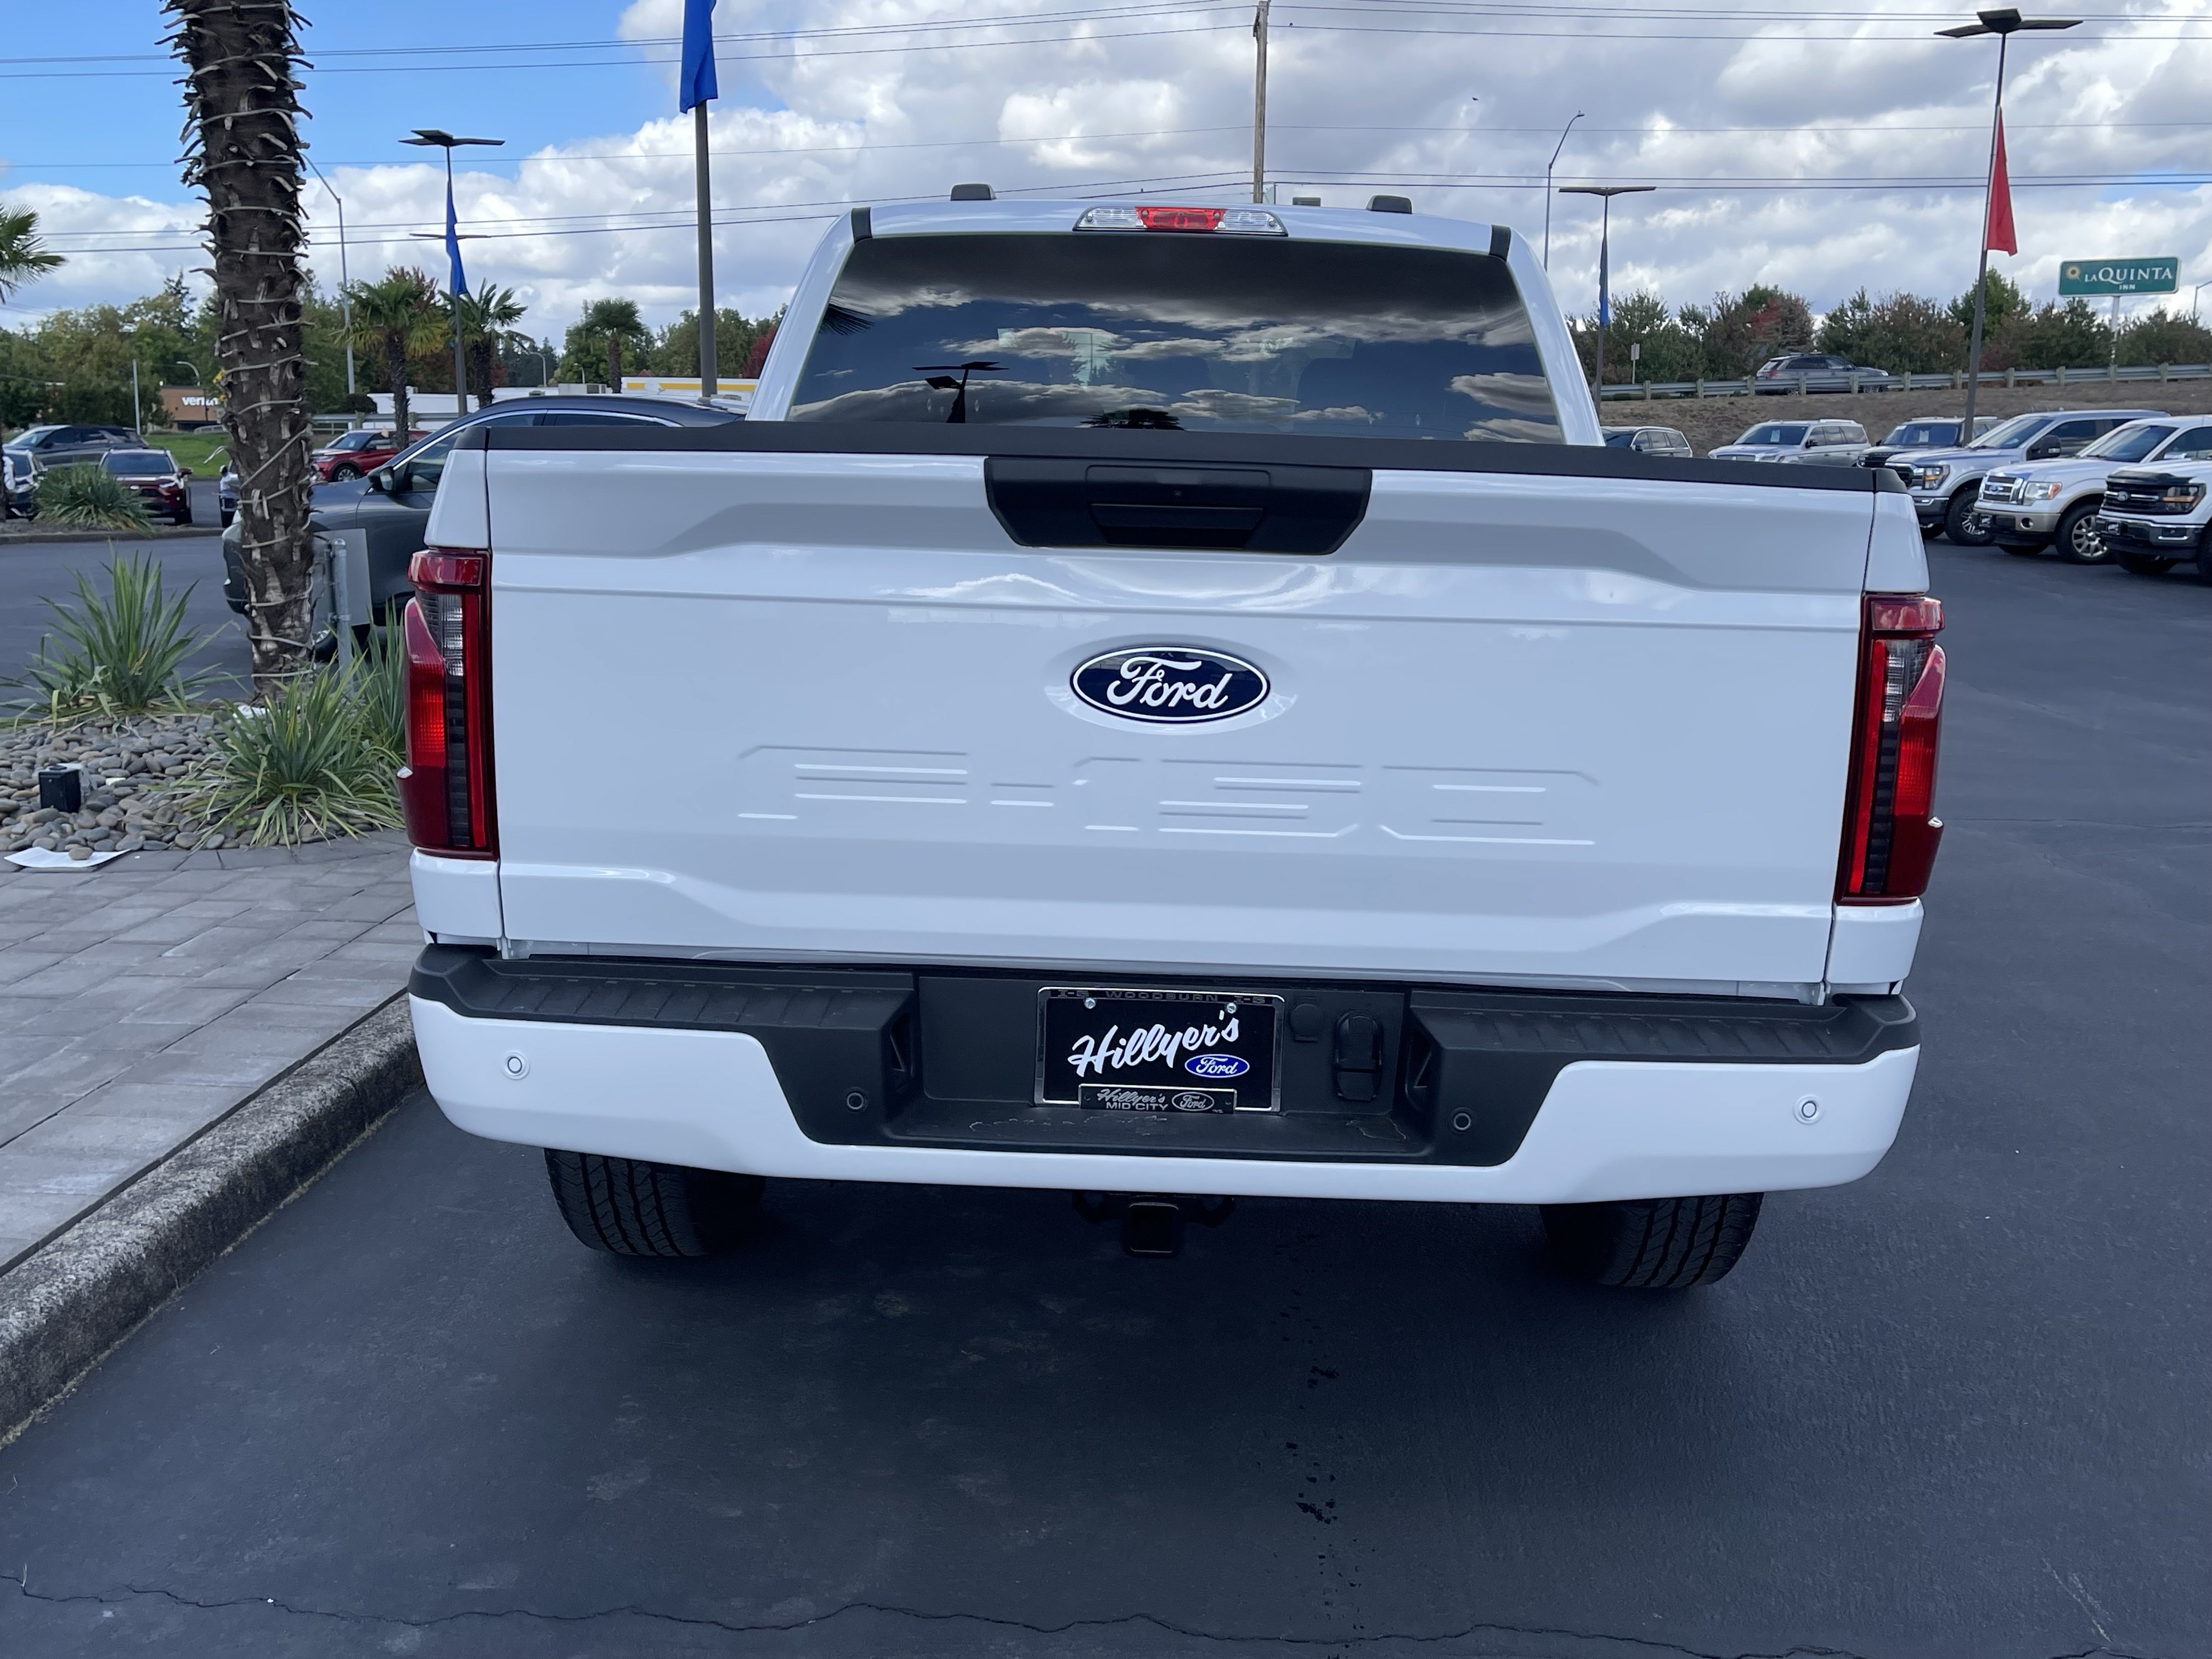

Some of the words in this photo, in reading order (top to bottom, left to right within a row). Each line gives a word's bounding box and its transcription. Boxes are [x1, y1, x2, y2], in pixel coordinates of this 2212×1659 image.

[2085, 274, 2097, 283] LA
[2098, 267, 2174, 285] QUINTA
[1106, 656, 1233, 709] Ford
[1058, 989, 1090, 998] I-5
[1105, 991, 1218, 1002] WOODBURN
[1067, 1010, 1239, 1077] Hillyer's
[1195, 1056, 1238, 1075] Ford
[1097, 1088, 1166, 1106] Hillyer's
[1180, 1094, 1206, 1109] Ford
[1135, 1103, 1169, 1111] CITY
